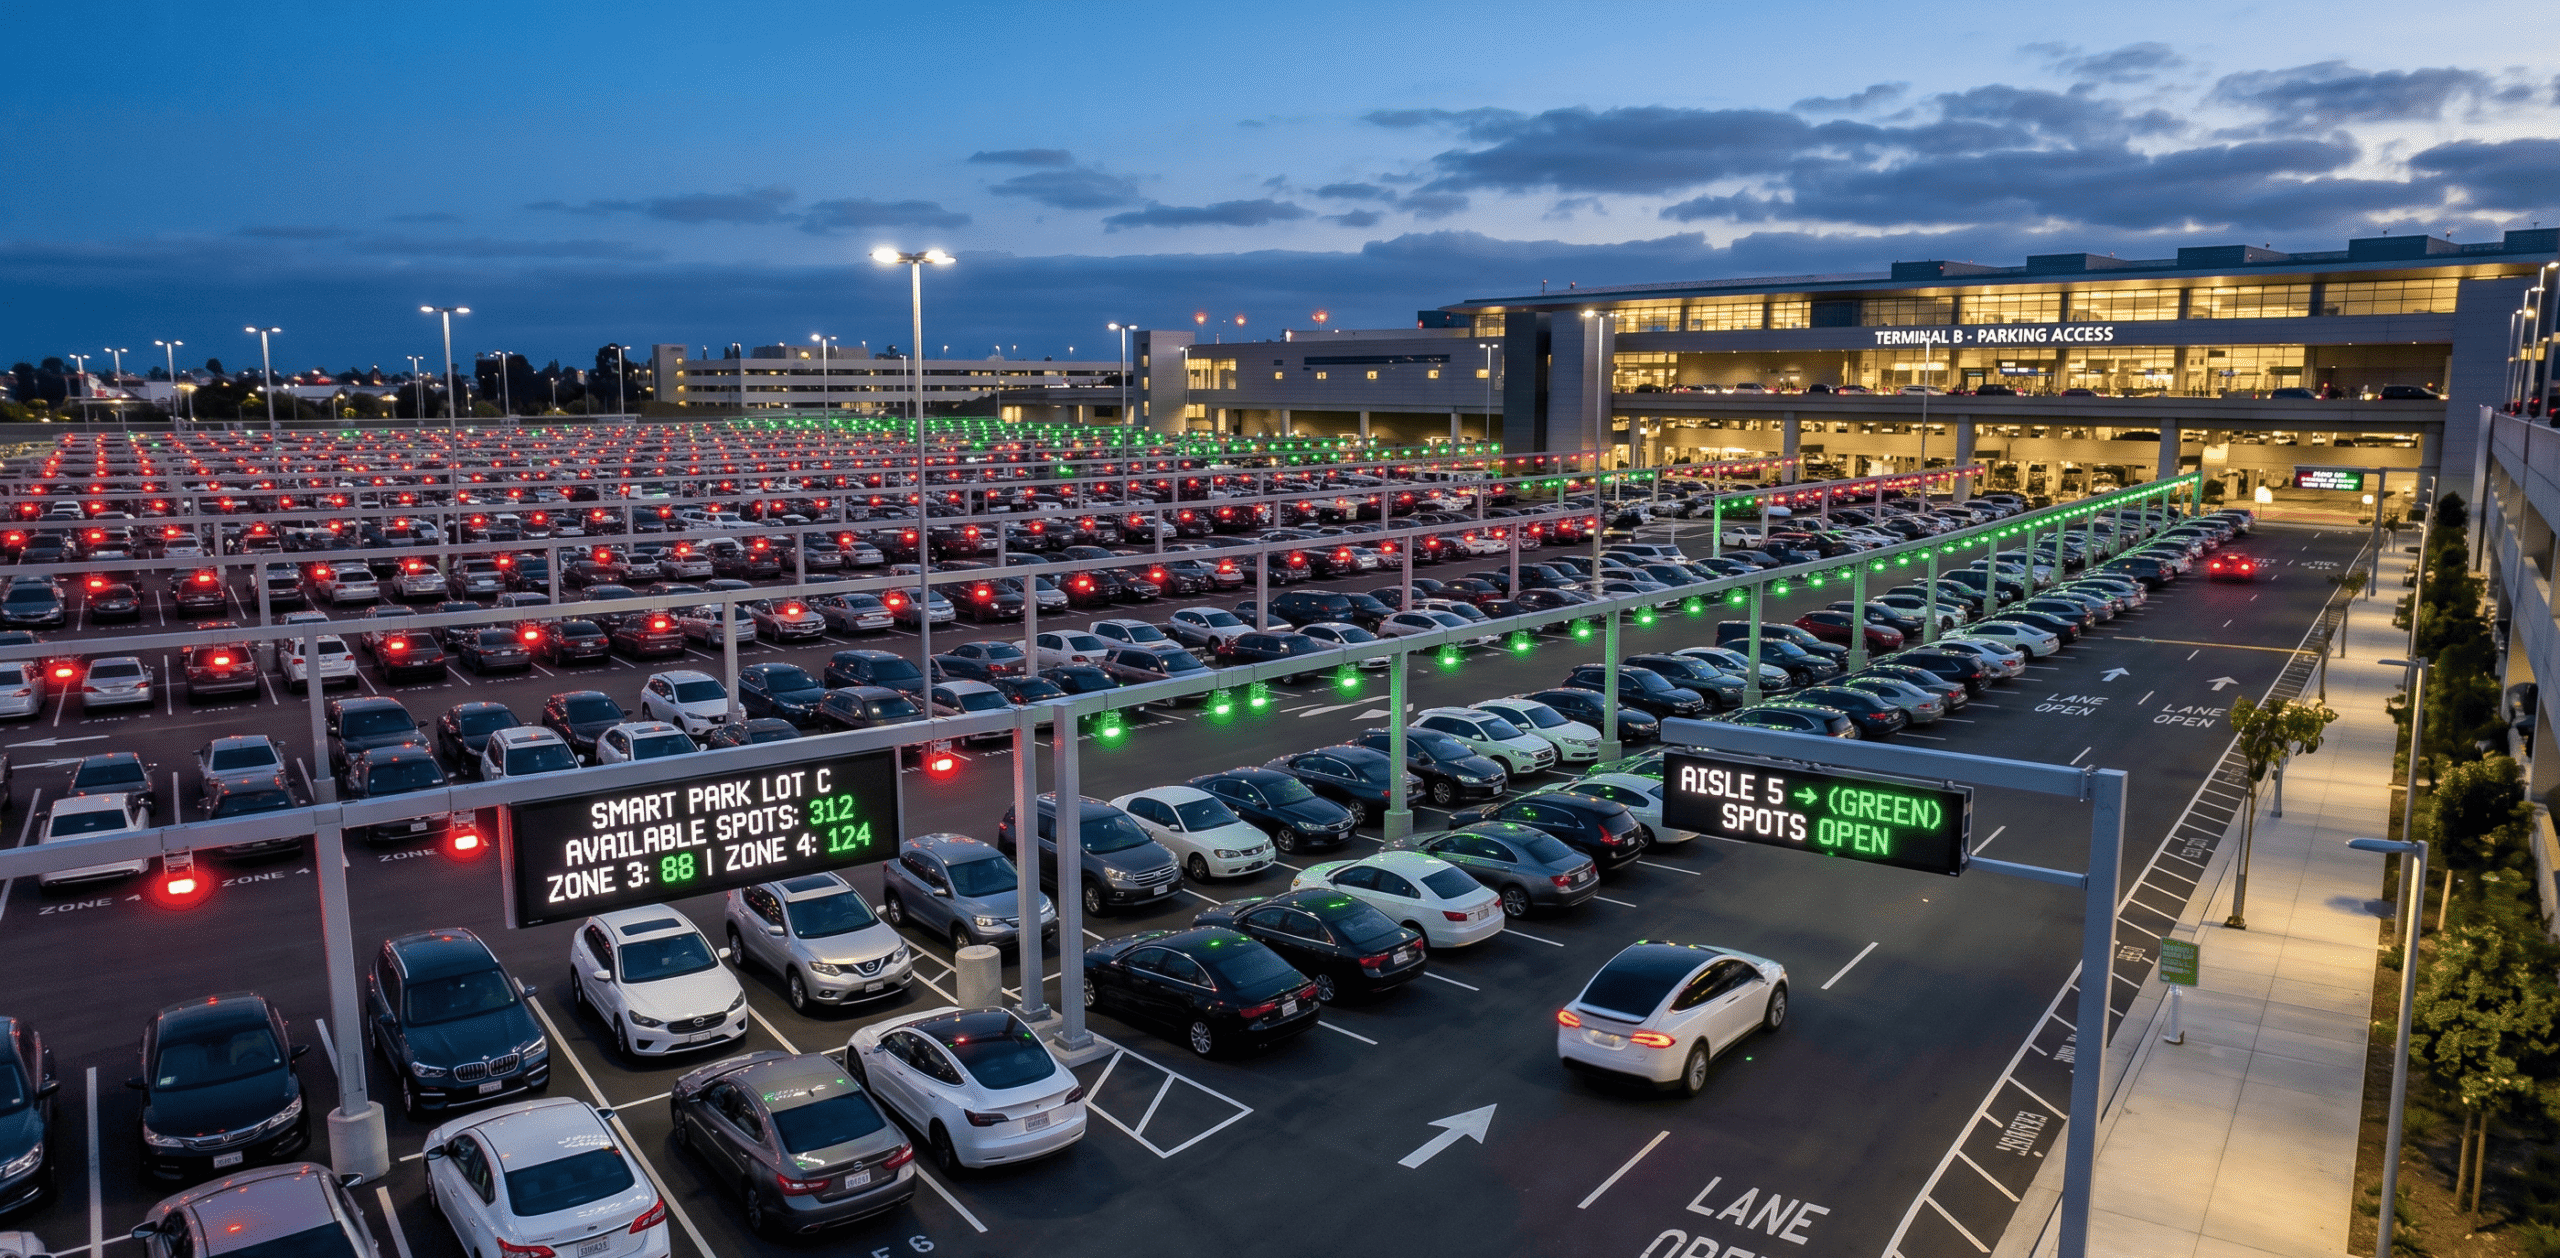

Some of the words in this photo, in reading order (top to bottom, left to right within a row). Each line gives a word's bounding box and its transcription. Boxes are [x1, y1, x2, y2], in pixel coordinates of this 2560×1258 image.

[1875, 330, 1949, 345] TERMINAL
[1953, 329, 1964, 344] B
[1977, 328, 2047, 343] PARKING
[2051, 326, 2114, 342] ACCESS
[2046, 693, 2109, 705] LANE
[2034, 703, 2096, 717] OPEN
[2161, 703, 2227, 717] LANE
[2153, 714, 2216, 728] OPEN
[591, 791, 677, 830] SMART
[688, 780, 751, 815] PARK
[762, 771, 806, 803] LOT
[817, 768, 832, 794] C
[1681, 765, 1756, 801] AISLE
[1767, 778, 1784, 804] 5
[1828, 786, 1941, 830] (GREEN)
[565, 819, 707, 867] AVAILABLE
[716, 805, 800, 841] SPOTS:
[809, 794, 855, 825] 312
[1722, 803, 1807, 841] SPOTS
[1818, 818, 1889, 855] OPEN
[378, 848, 438, 863] ZONE
[547, 866, 616, 904] ZONE
[627, 862, 650, 888] 3:
[661, 853, 694, 883] 88
[725, 836, 787, 872] ZONE
[796, 833, 817, 857] 4:
[827, 821, 871, 853] 124
[222, 870, 286, 888] ZONE
[38, 898, 112, 916] ZONE
[1686, 1176, 1831, 1245] LANE
